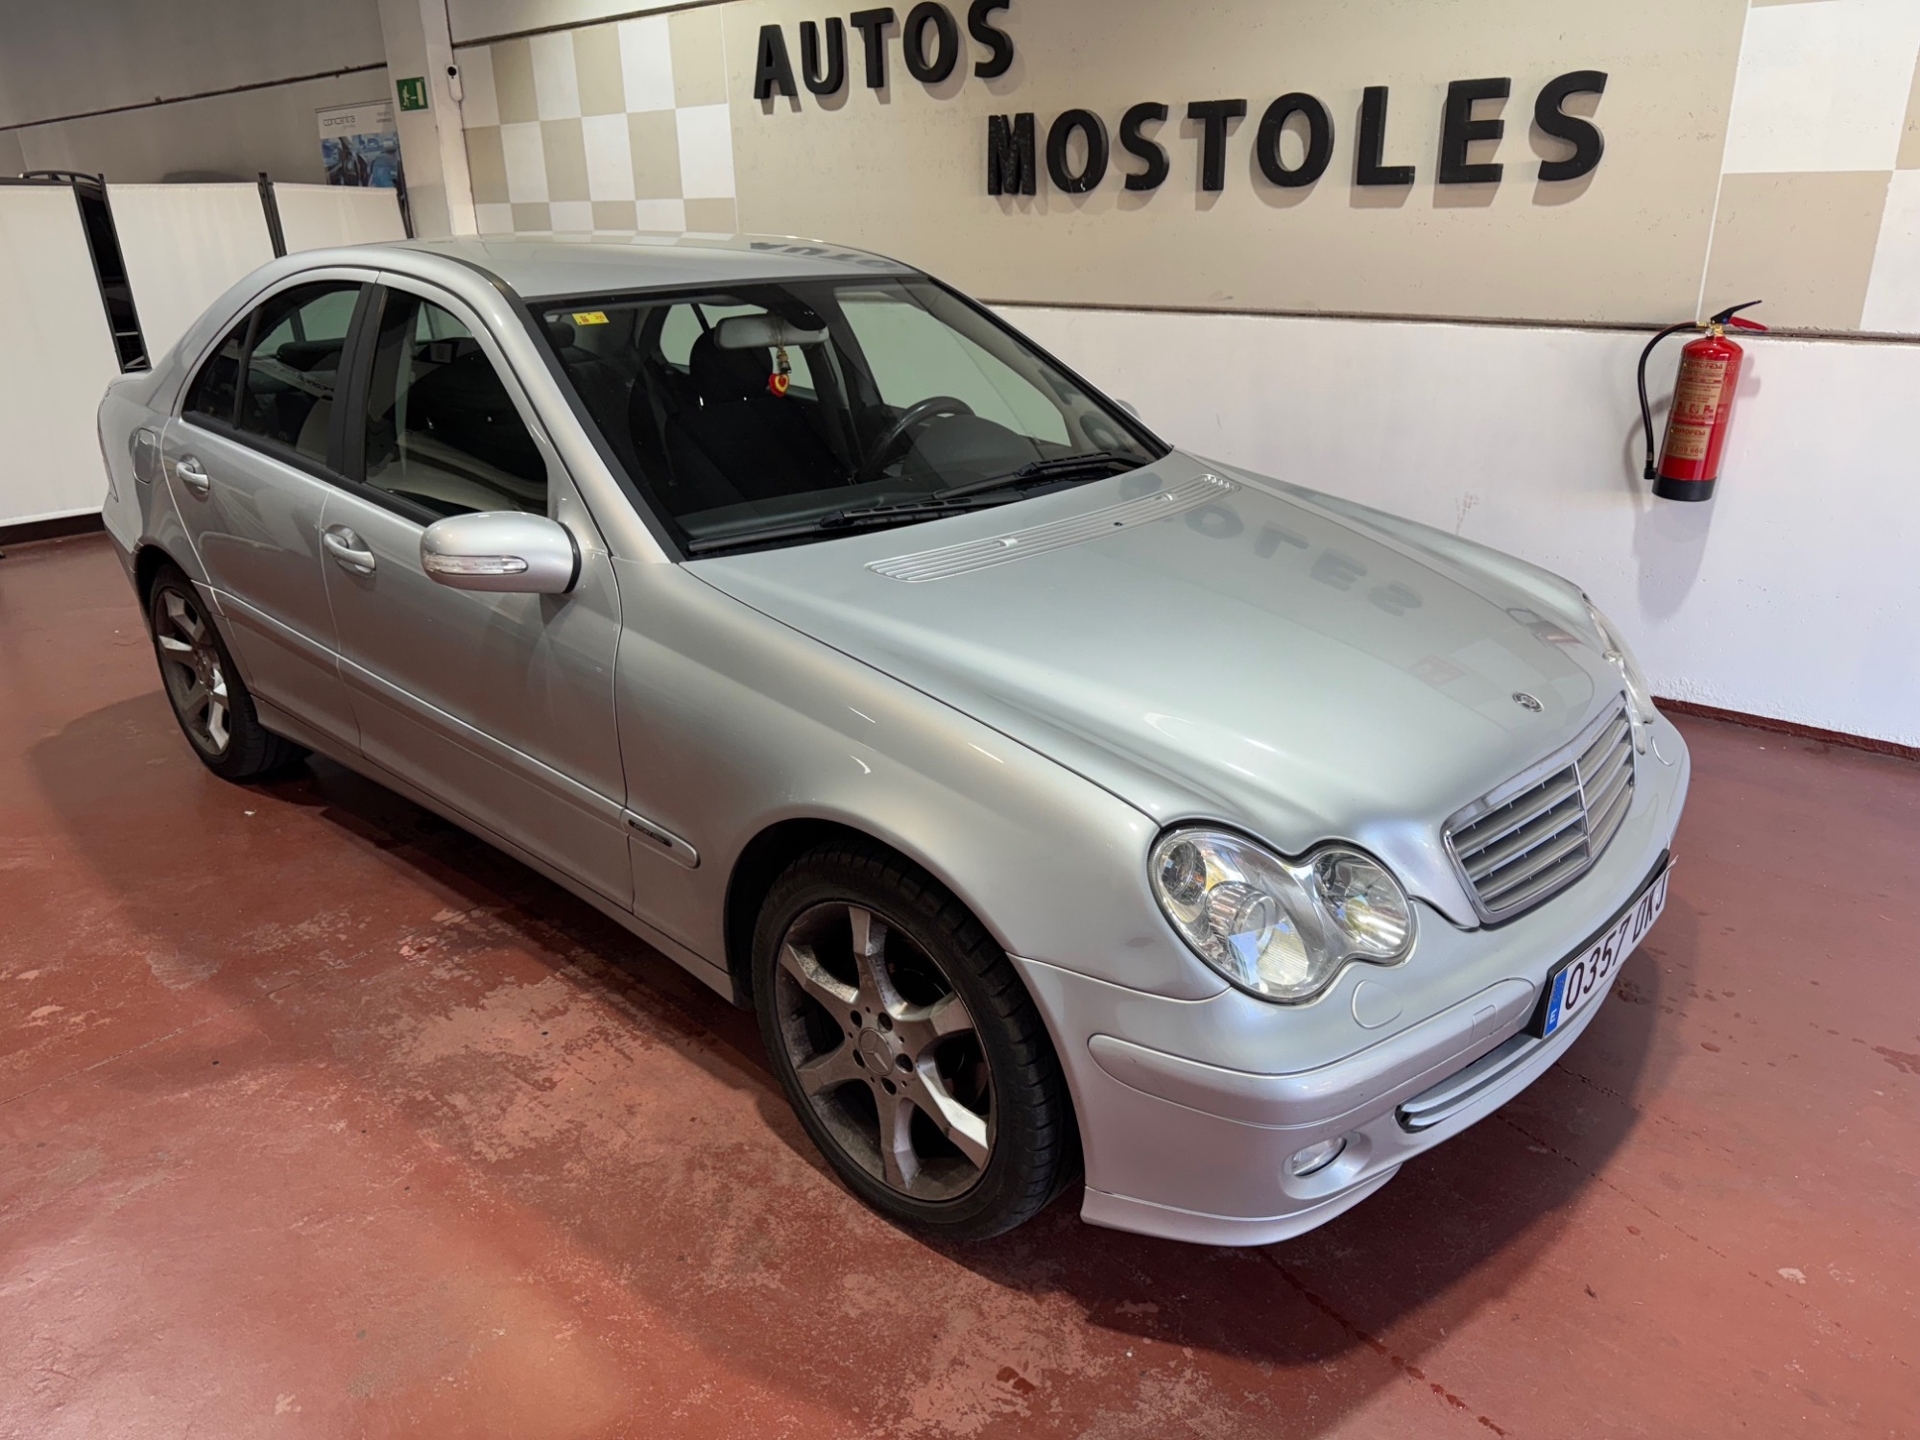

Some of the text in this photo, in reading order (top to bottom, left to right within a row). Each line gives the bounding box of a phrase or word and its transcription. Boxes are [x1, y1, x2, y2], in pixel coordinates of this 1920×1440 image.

[753, 0, 1014, 100] AUTOS
[987, 70, 1608, 197] MOSTOLES
[1565, 870, 1668, 1010] 0357 DKJ
[1549, 1009, 1557, 1024] E
